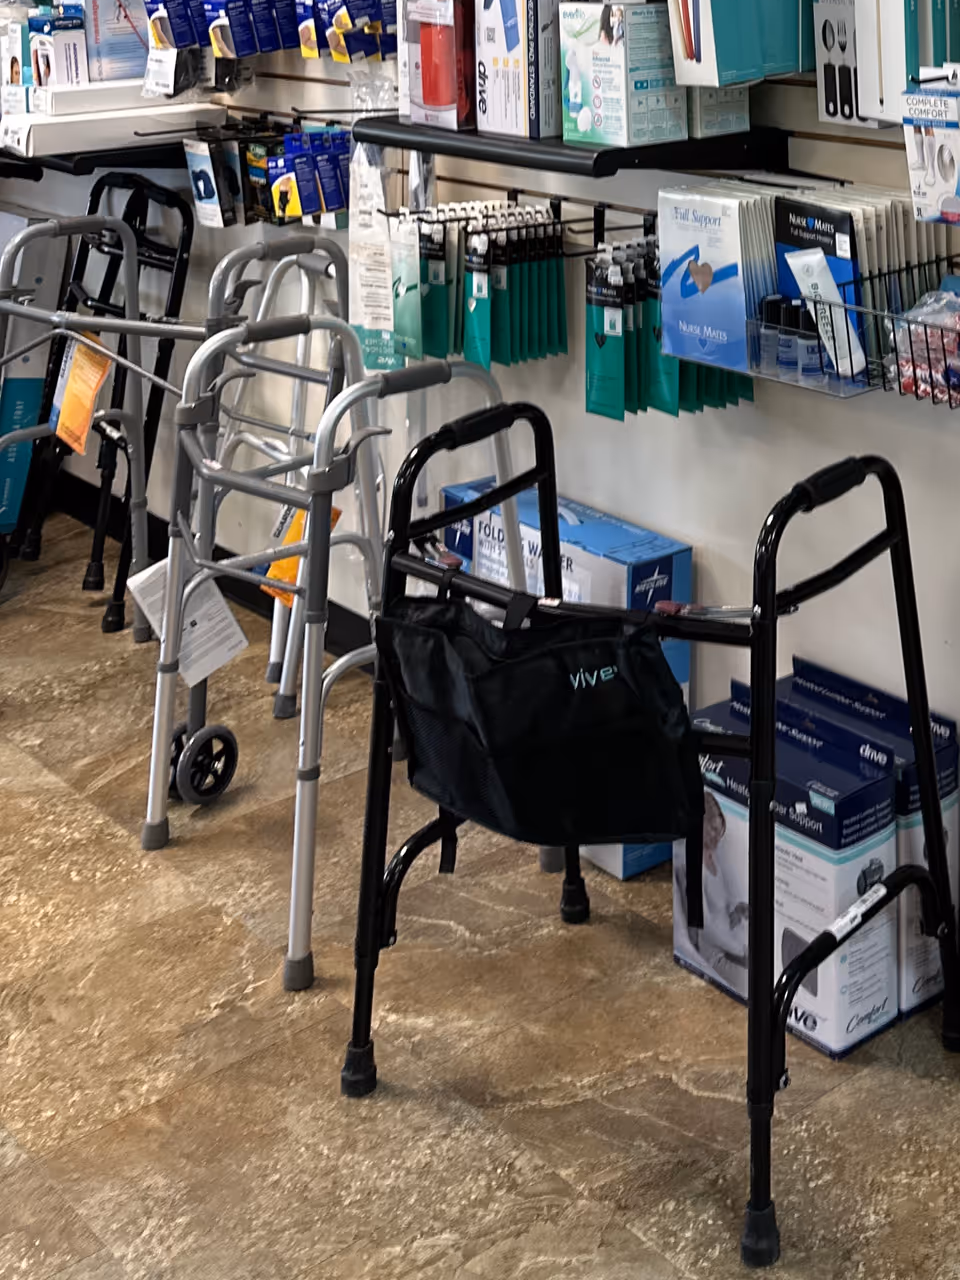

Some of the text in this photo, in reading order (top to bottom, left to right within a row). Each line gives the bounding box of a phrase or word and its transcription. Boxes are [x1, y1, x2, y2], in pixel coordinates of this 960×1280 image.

[478, 60, 488, 115] drive
[906, 97, 949, 108] COMPLETE
[909, 108, 949, 119] COMFORT
[674, 207, 721, 227] Full Support
[789, 213, 835, 233] NURSE MATES
[790, 227, 798, 236] Full
[799, 229, 816, 240] Support
[679, 320, 728, 341] NURSE MATES
[528, 543, 573, 571] WAER
[570, 667, 615, 690] vive
[860, 743, 888, 766] drive
[726, 776, 823, 833] Heate Support
[847, 997, 888, 1033] Comfort
